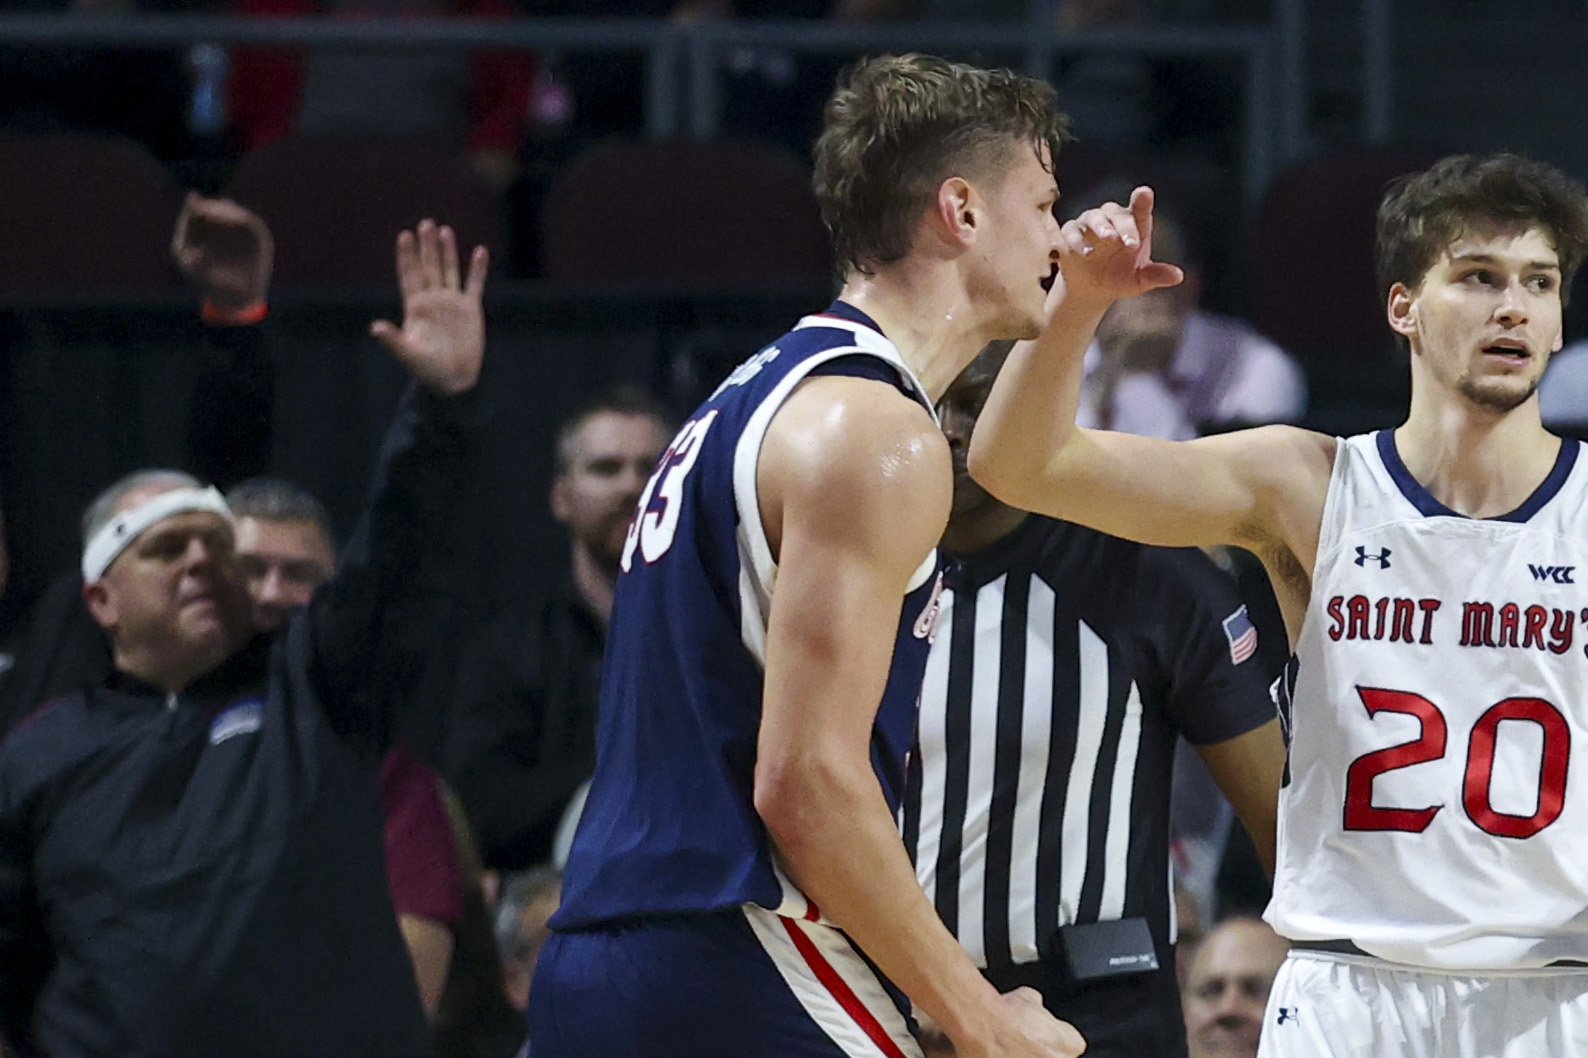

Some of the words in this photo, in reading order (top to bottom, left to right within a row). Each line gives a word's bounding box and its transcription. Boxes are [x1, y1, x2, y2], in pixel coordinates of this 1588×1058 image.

[1527, 563, 1576, 584] WCC
[1327, 594, 1442, 645] SAINT
[1342, 684, 1571, 840] 20
